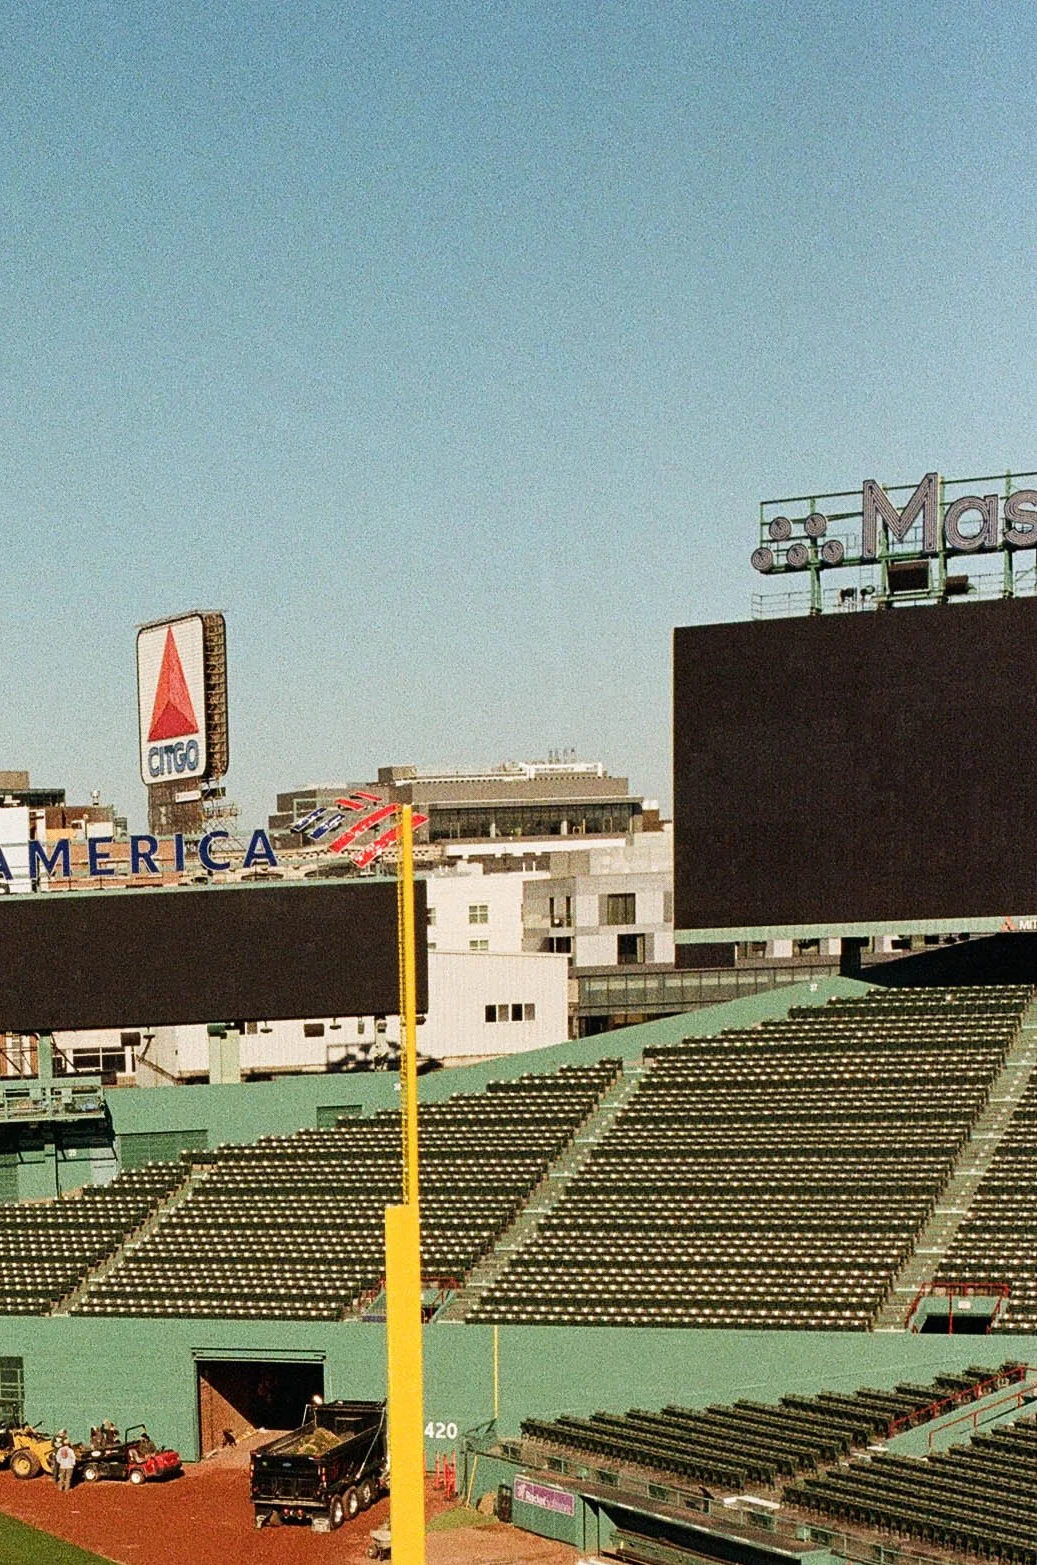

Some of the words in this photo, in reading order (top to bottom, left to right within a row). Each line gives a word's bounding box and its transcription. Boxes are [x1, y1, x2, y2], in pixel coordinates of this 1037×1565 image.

[862, 472, 1037, 561] Mas
[148, 739, 199, 777] CITGO
[424, 1421, 458, 1440] 420
